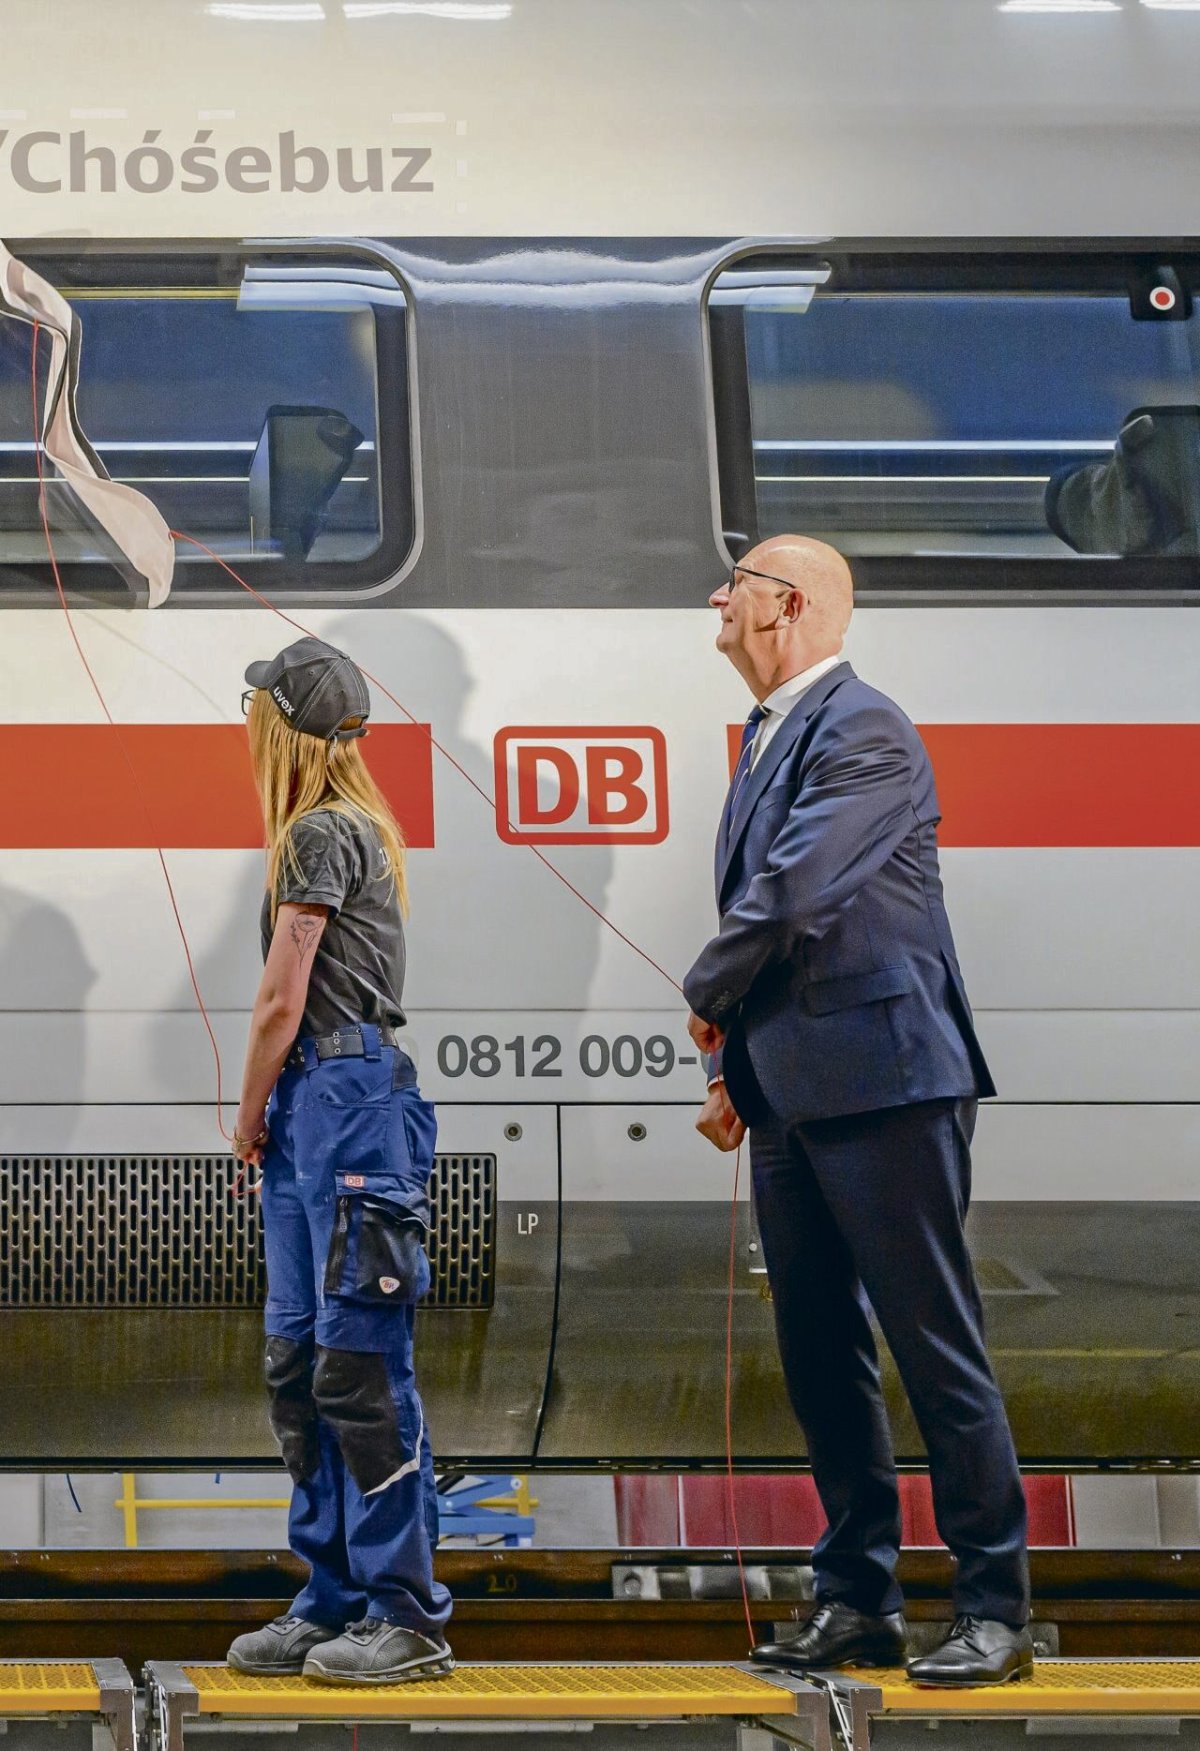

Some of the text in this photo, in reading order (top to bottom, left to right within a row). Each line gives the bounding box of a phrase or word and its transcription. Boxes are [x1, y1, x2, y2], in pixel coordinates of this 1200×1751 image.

[273, 686, 295, 717] uvex
[517, 746, 649, 825] DB
[437, 1035, 708, 1078] 0812 009-
[347, 1176, 362, 1186] DB
[517, 1213, 539, 1235] LP
